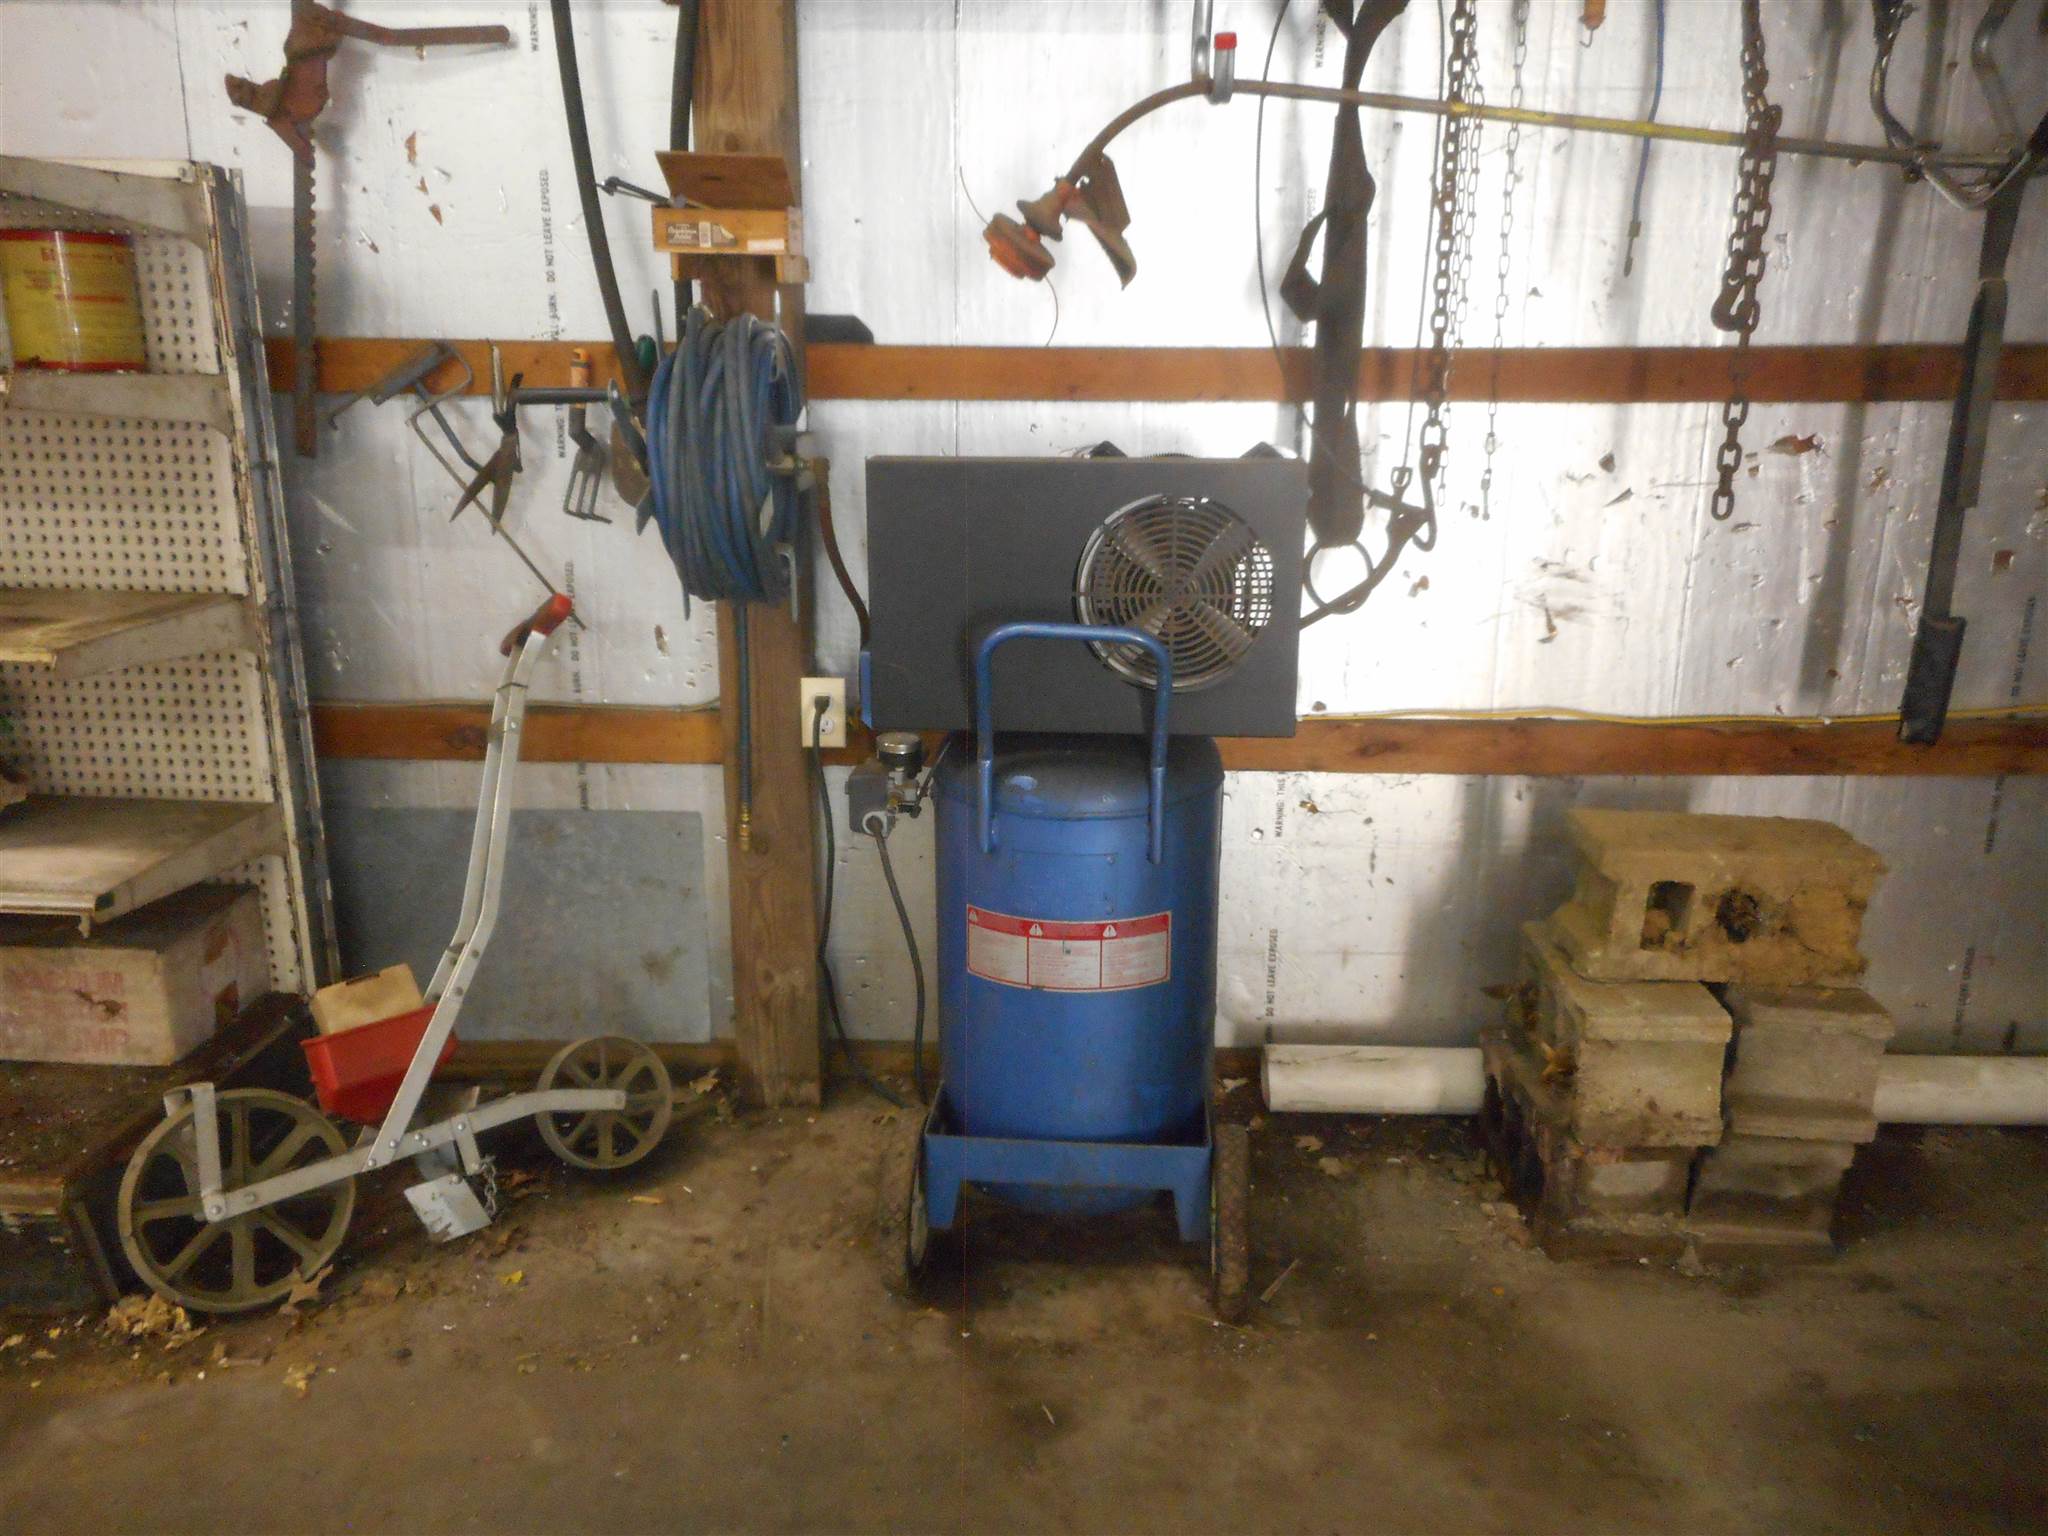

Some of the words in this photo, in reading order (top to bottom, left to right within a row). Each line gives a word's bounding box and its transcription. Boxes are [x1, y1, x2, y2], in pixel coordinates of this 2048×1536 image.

[541, 217, 553, 245] LEAVE
[544, 249, 555, 267] NOT
[545, 270, 556, 283] DO
[1276, 778, 1286, 796] THIS
[1266, 965, 1276, 988] LEAVE
[1266, 991, 1275, 1004] NOT
[1265, 1007, 1274, 1017] DO
